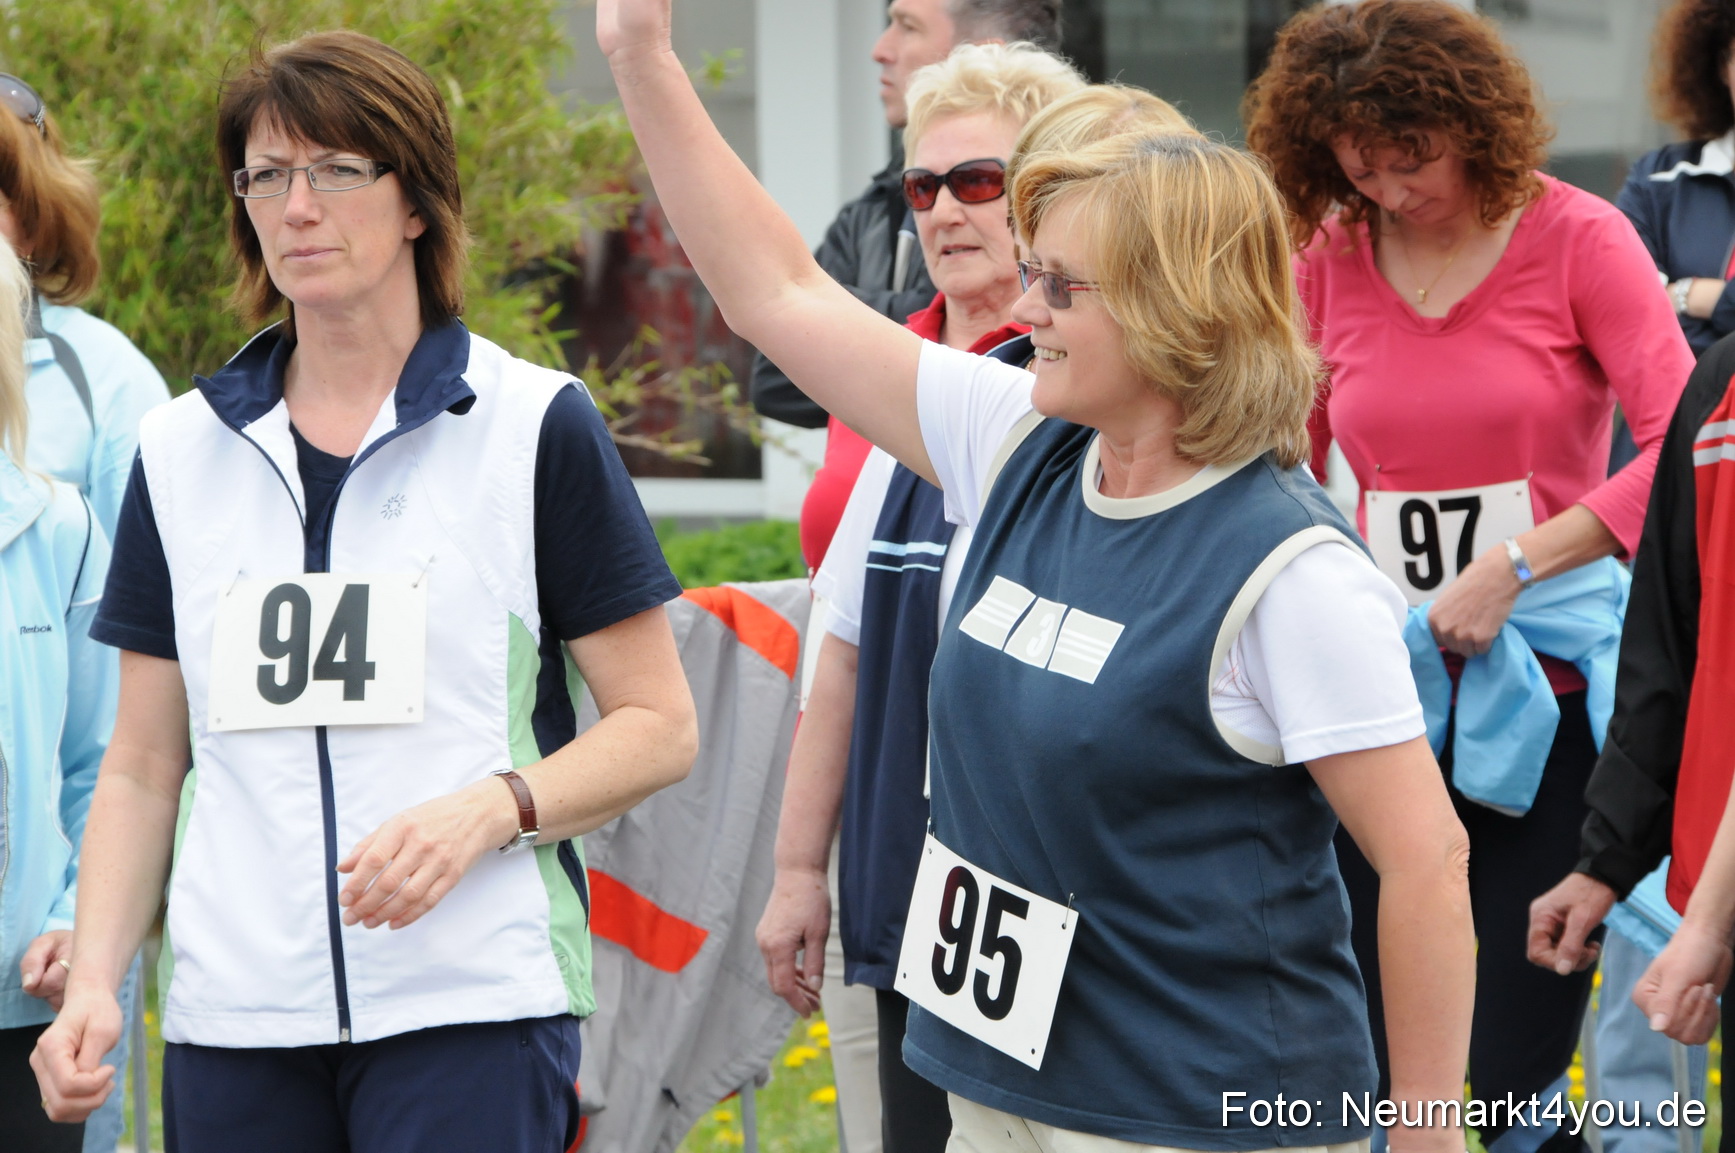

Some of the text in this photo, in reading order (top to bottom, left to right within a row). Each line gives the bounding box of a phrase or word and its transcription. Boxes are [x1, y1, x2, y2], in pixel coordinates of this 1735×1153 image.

[1399, 496, 1482, 591] 97
[19, 624, 53, 636] Reebok
[257, 582, 376, 705] 94
[1027, 612, 1055, 658] 3
[931, 866, 1029, 1020] 95
